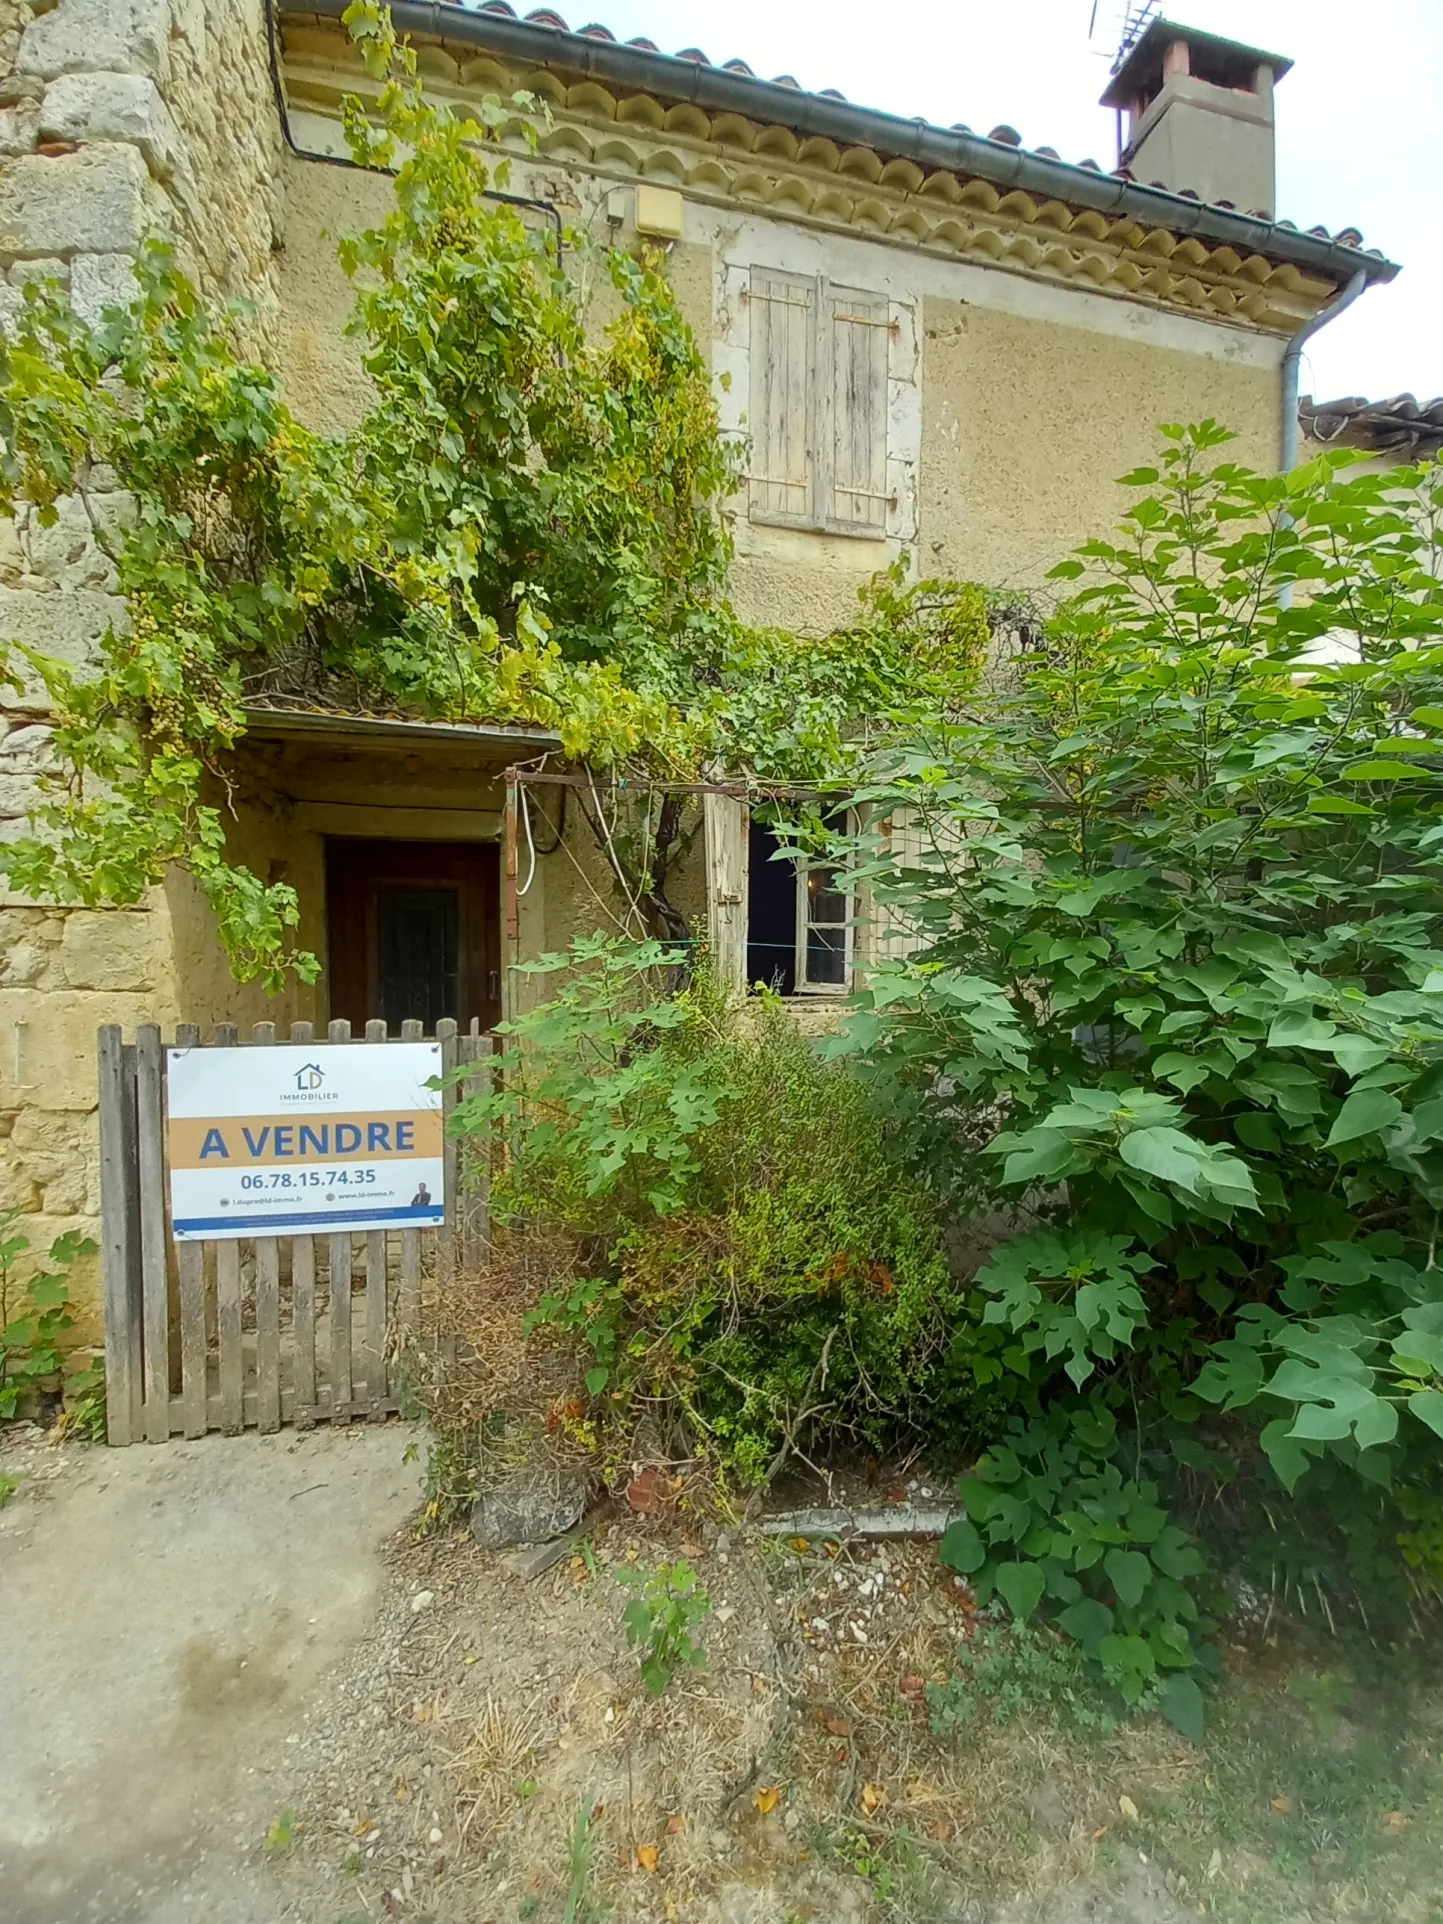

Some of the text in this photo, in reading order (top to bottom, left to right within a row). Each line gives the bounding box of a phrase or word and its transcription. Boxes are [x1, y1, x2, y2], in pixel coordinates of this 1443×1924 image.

[297, 1071, 323, 1090] LD
[280, 1092, 339, 1101] IMMOBILIER
[199, 1121, 414, 1160] A VENDRE
[241, 1169, 376, 1190] 06.78.15.74.35
[338, 1190, 395, 1200] www.ld-immo.fr
